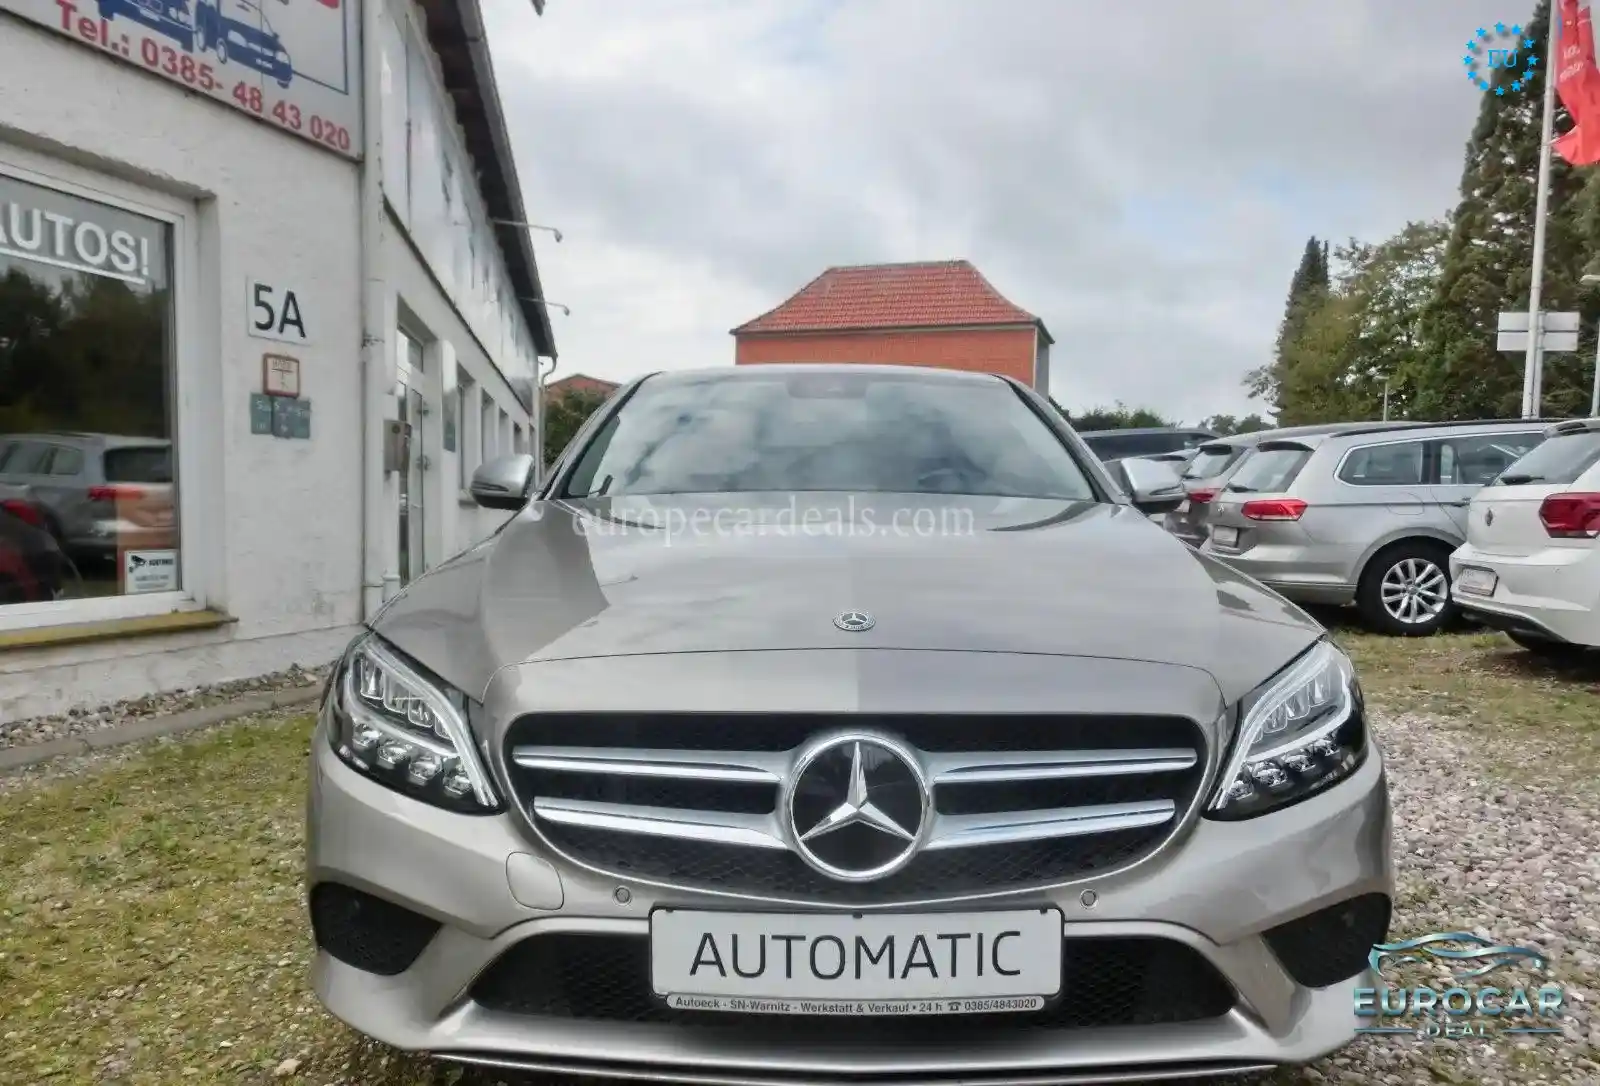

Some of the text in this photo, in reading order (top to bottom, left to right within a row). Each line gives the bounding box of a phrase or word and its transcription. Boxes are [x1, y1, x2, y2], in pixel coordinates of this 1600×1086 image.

[57, 0, 130, 57] Tel.:
[232, 80, 263, 114] 48
[272, 100, 302, 130] 43
[310, 115, 350, 150] 020
[0, 202, 149, 276] UTOS!
[254, 283, 306, 338] 5A
[689, 930, 1021, 980] AUTOMATIC
[675, 996, 1037, 1014] Autoeck SN-Warnitz Werkstatt & Verkauf 24 h 0385/4843020
